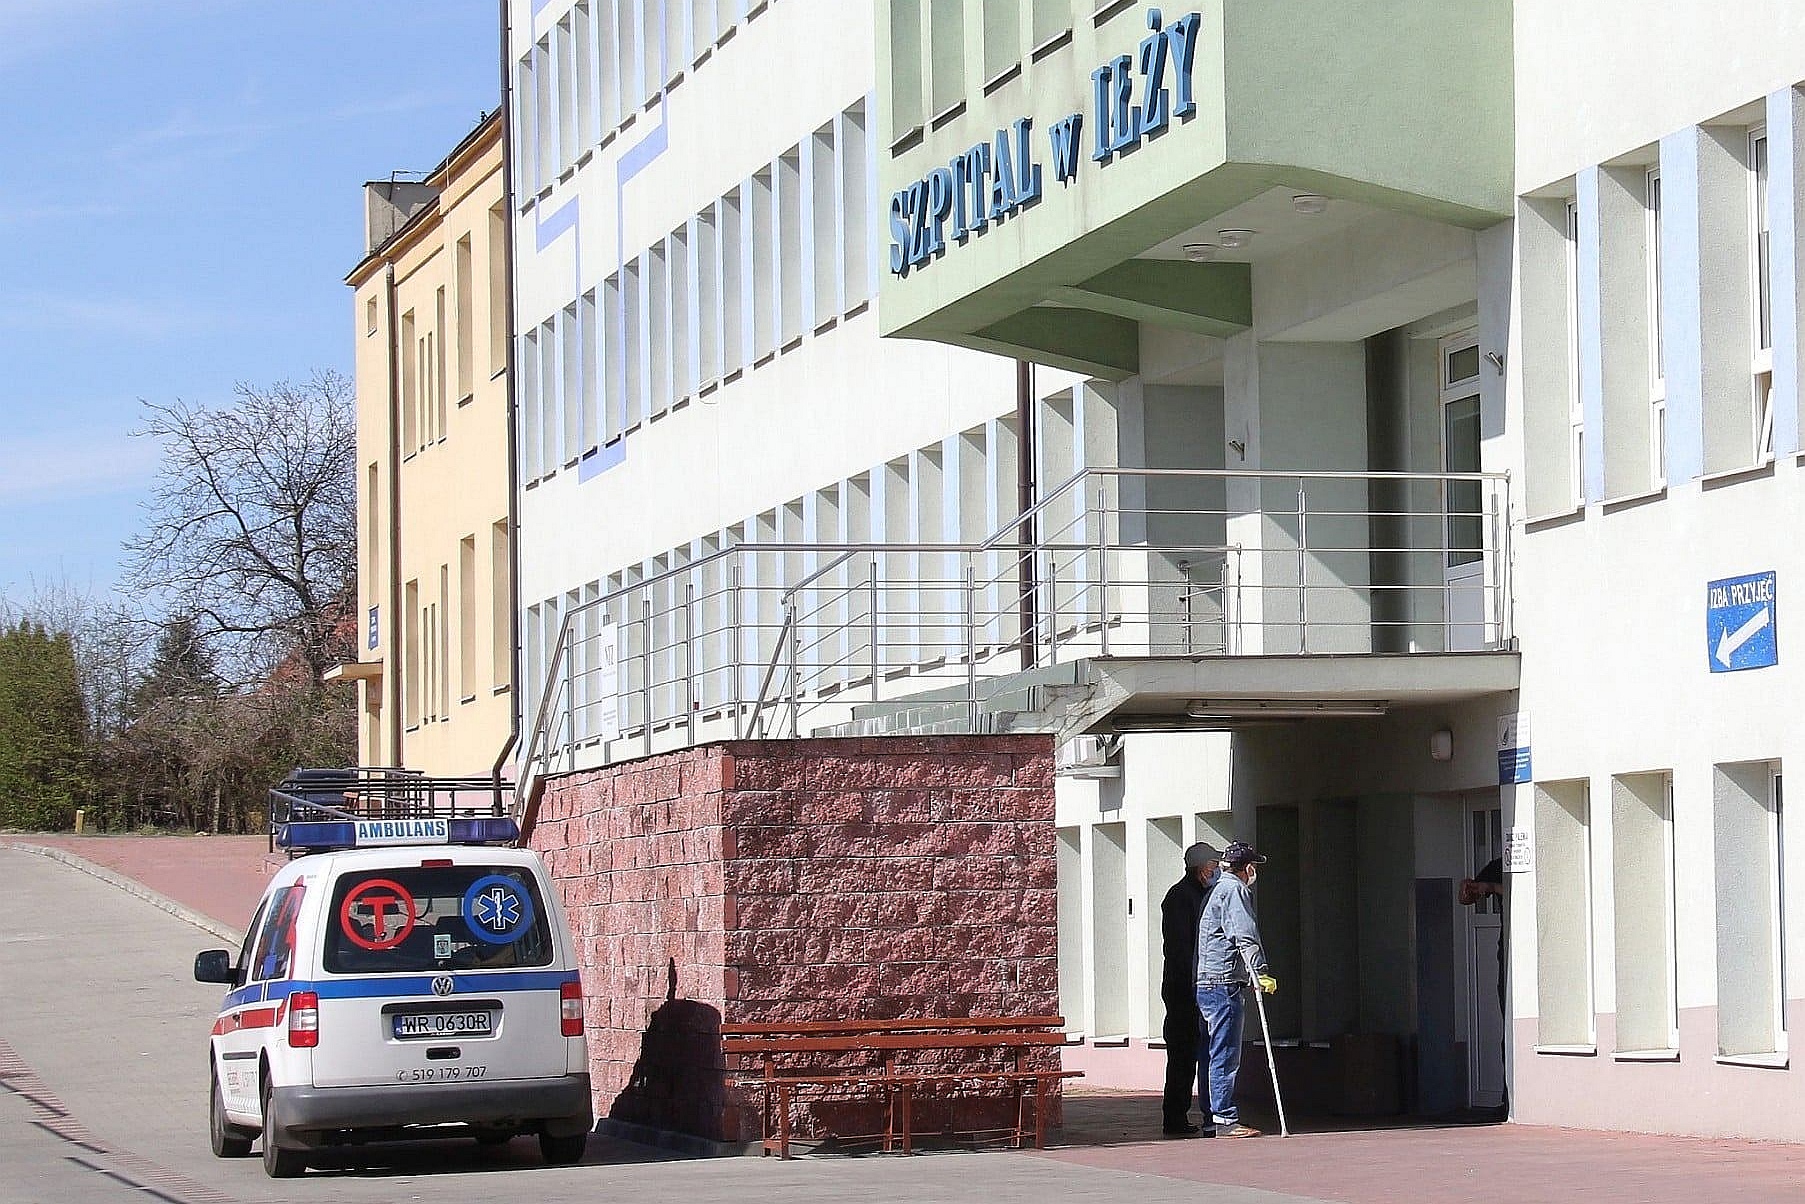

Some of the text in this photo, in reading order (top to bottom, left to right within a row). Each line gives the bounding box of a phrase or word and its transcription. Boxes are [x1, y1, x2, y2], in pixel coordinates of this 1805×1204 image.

[890, 115, 1042, 279] SZPITAL
[1710, 585, 1729, 609] IZBA
[359, 820, 446, 838] AMBULANS
[362, 896, 396, 938] T
[405, 1016, 429, 1032] WR
[435, 1014, 487, 1031] 0630R
[412, 1066, 487, 1080] 519 179 707
